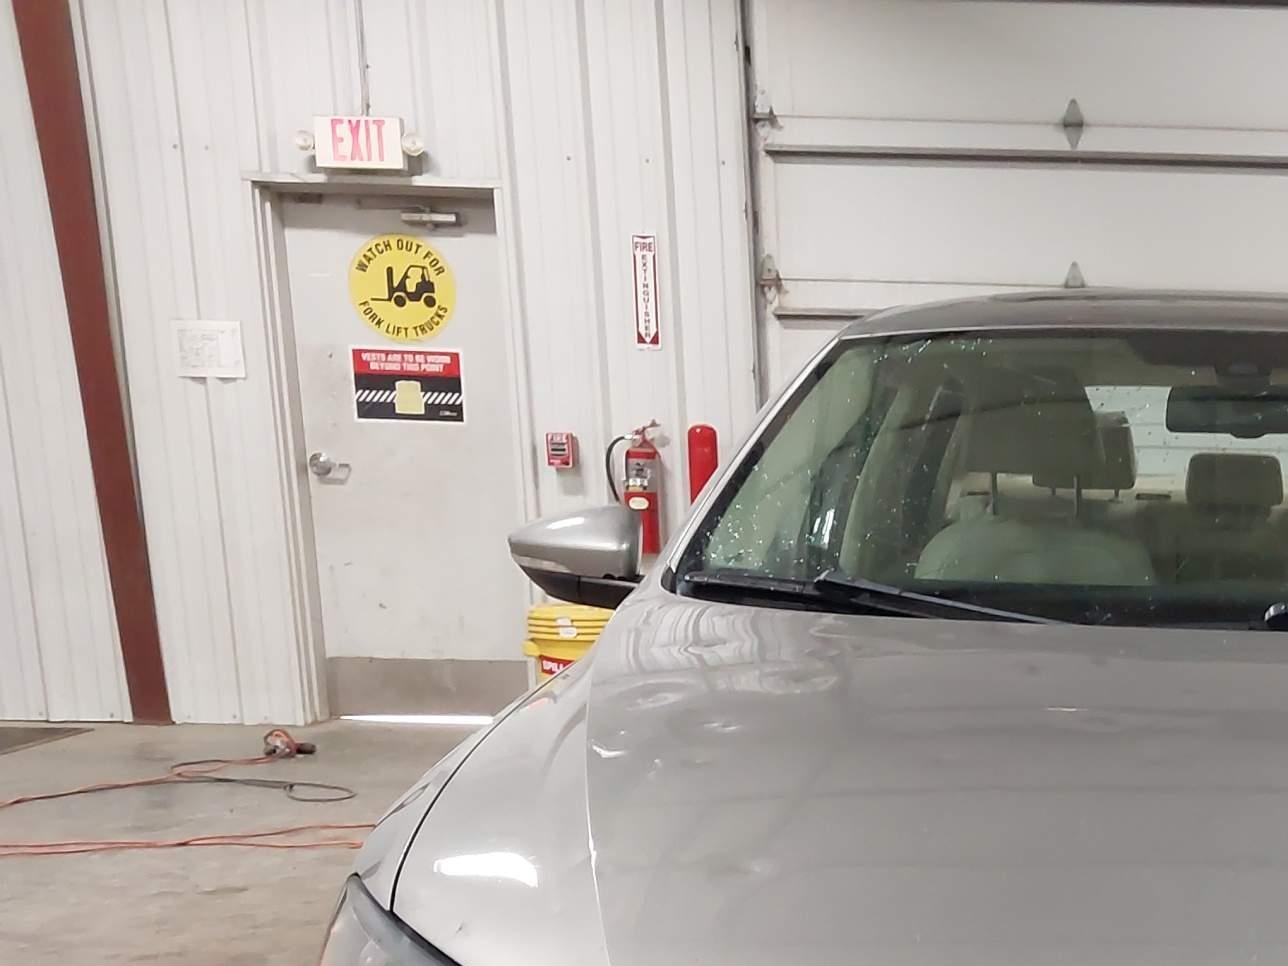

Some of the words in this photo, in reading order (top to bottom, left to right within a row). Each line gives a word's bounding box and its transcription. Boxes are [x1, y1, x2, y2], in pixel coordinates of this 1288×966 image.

[330, 118, 385, 162] EXIT
[356, 239, 393, 273] WATCH
[396, 238, 423, 255] OUT
[422, 250, 446, 277] FOR
[634, 241, 655, 252] FIRE
[358, 300, 385, 329] FORK
[384, 322, 409, 339] LIFT
[412, 303, 449, 338] TRUCKS
